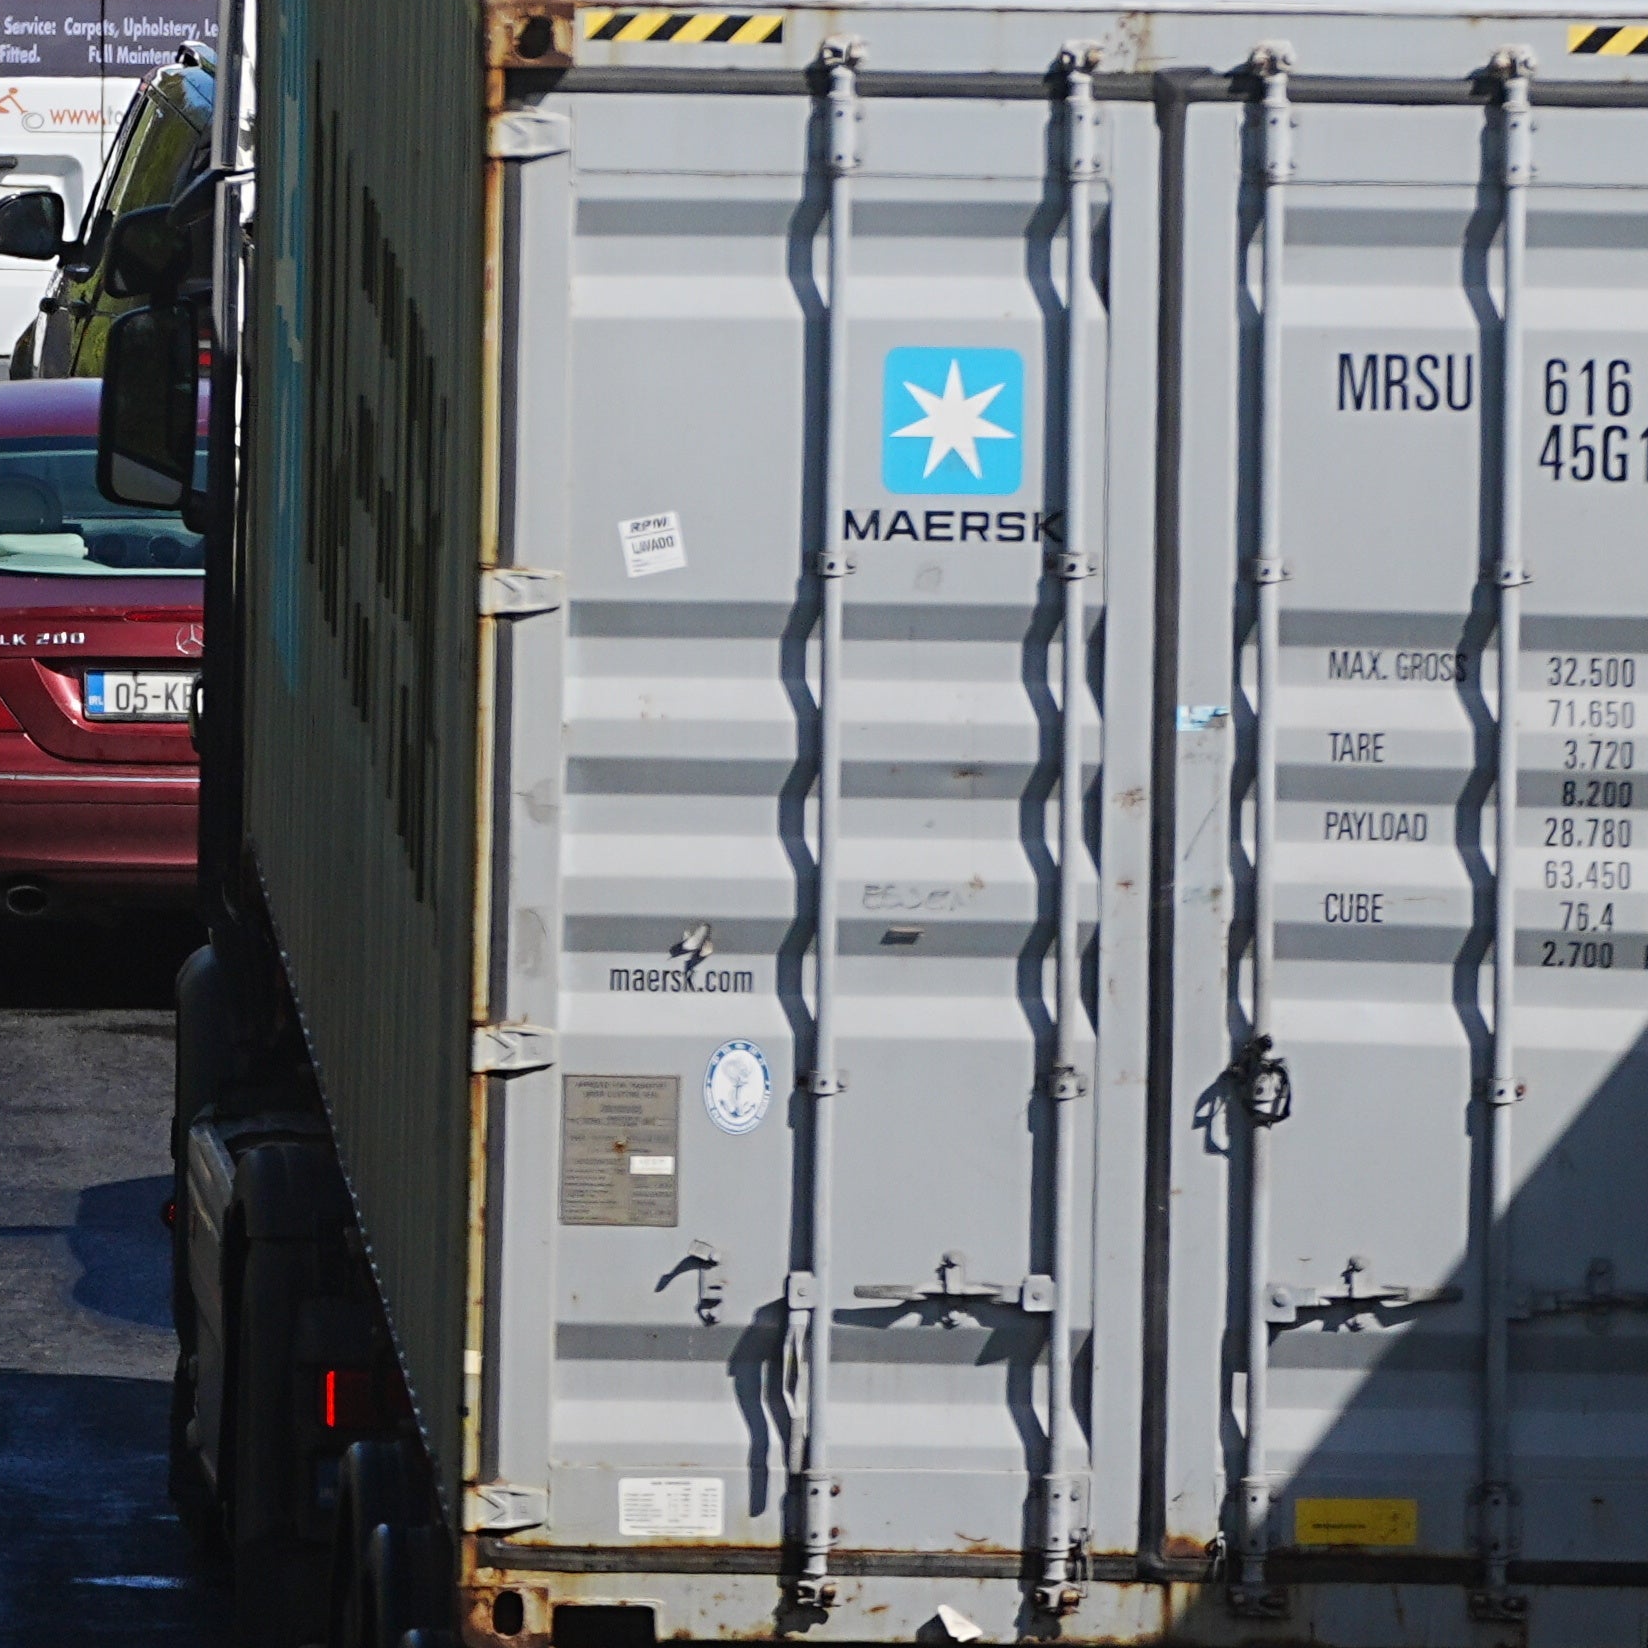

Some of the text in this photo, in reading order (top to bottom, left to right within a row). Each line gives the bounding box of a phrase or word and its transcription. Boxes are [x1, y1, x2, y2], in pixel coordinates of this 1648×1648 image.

[4, 15, 57, 36] Service:
[64, 16, 119, 40] Carpets,
[123, 16, 201, 41] Upholstery,
[0, 43, 41, 63] Fitted.
[88, 45, 113, 64] Full
[1337, 353, 1474, 411] MRSU
[1544, 358, 1633, 417] 616
[842, 509, 1065, 543] MAERSK
[35, 631, 86, 645] 200
[1328, 650, 1387, 682] MAX.
[1395, 652, 1467, 683] GROSS
[1547, 656, 1636, 688] 32.500
[1328, 732, 1385, 763] TARE
[1560, 781, 1633, 808] 8.200
[1323, 811, 1428, 842] PAYLOAD
[1323, 893, 1384, 924] CUBE
[1559, 902, 1614, 932] 76.4
[1542, 941, 1615, 969] 2.700
[609, 967, 753, 993] maersk.com
